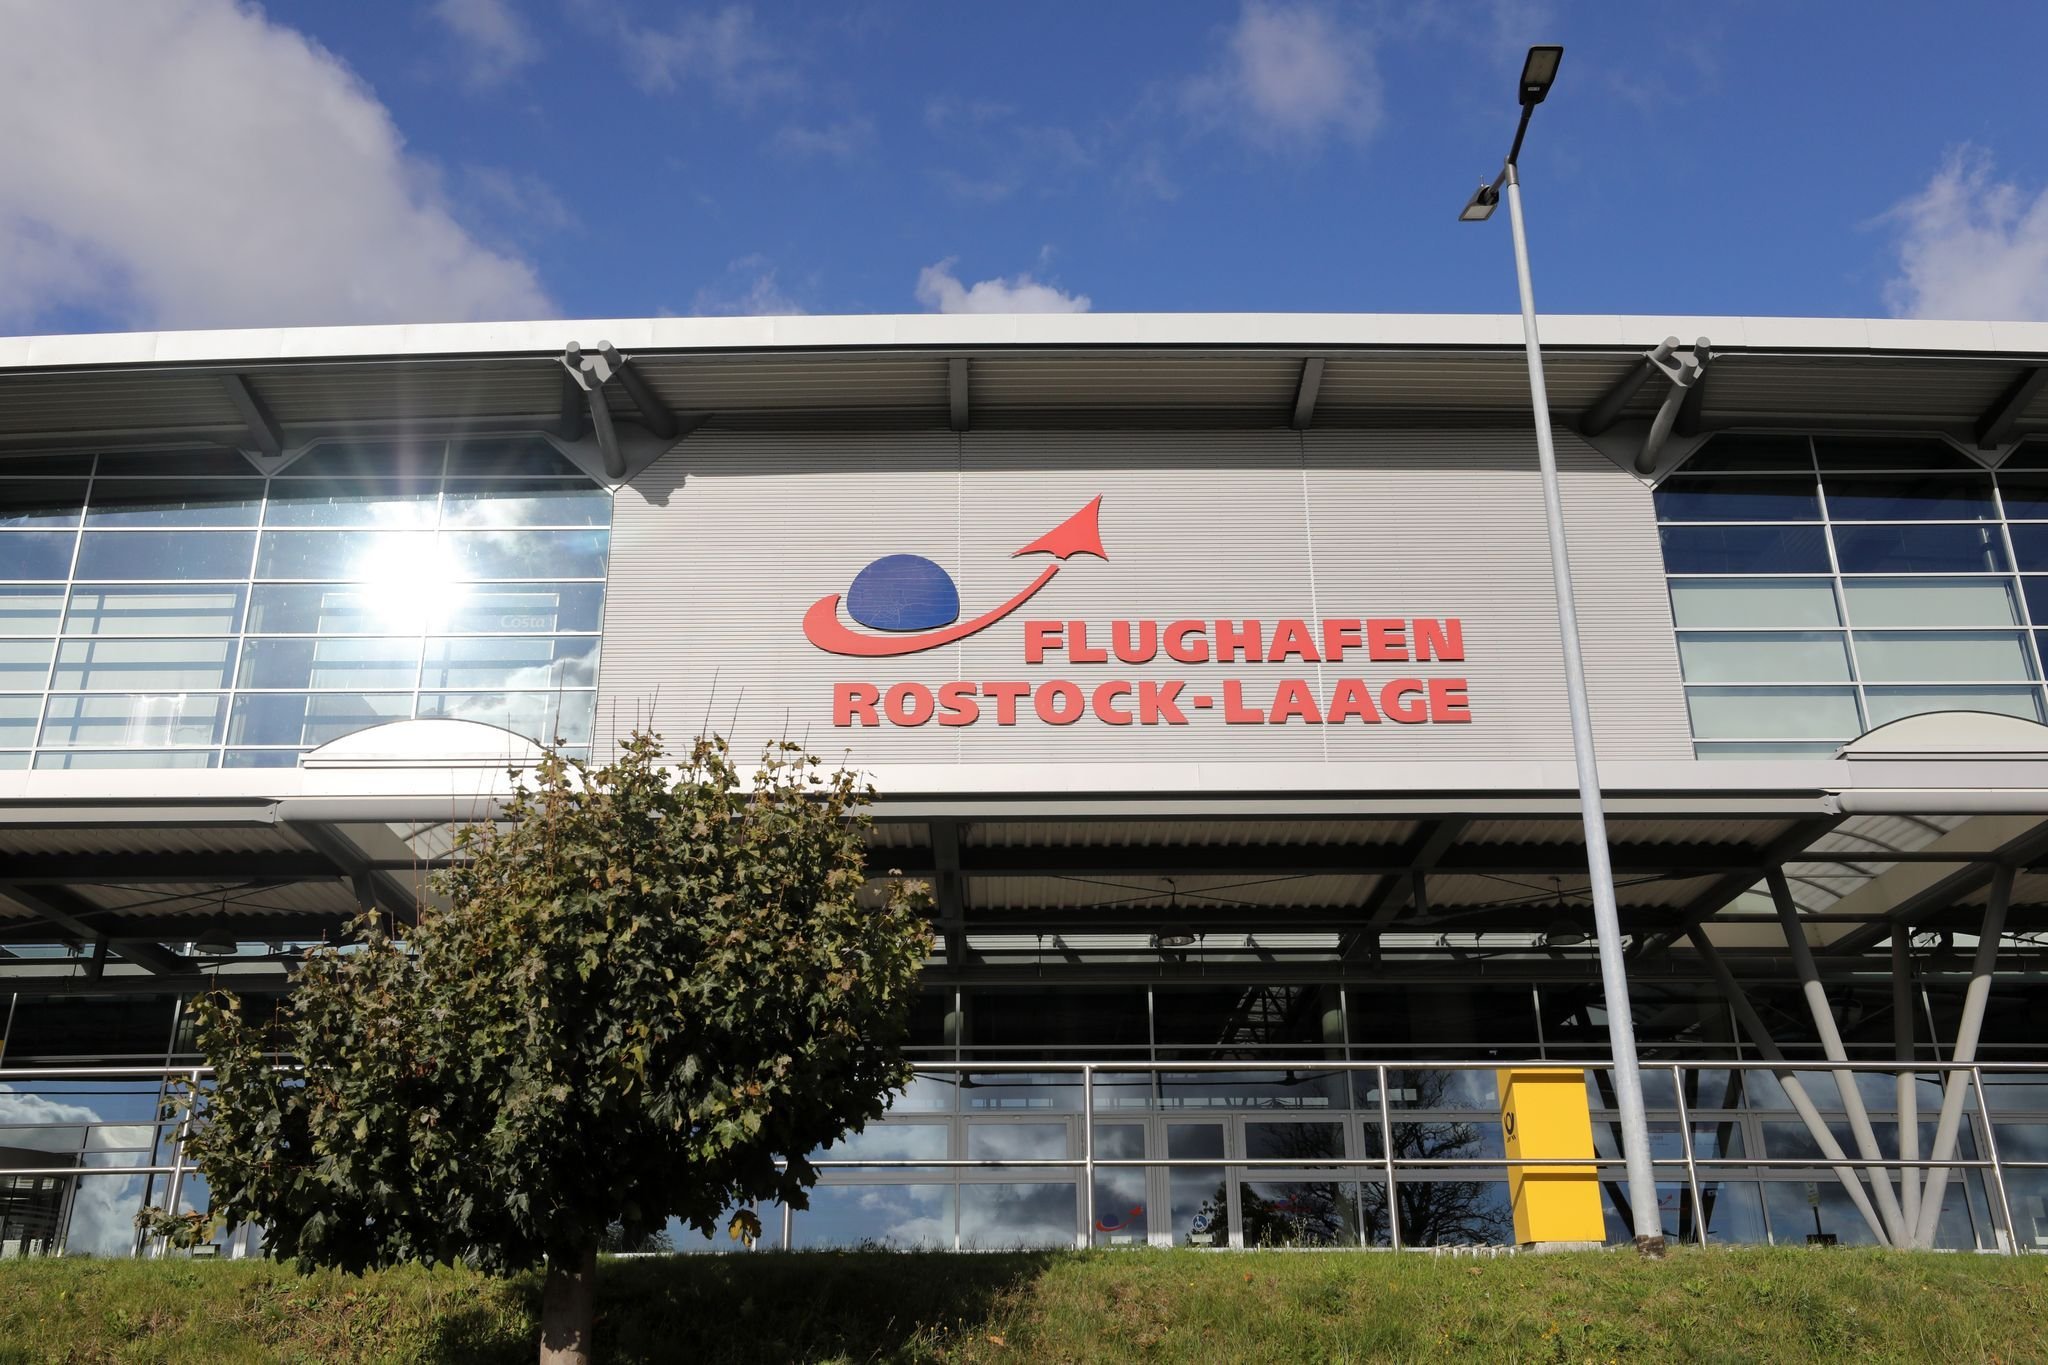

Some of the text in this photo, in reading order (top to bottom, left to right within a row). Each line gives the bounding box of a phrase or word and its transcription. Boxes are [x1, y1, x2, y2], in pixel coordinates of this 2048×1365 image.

[501, 614, 545, 629] Costa
[1024, 619, 1466, 664] FLUGHAFEN
[832, 678, 1472, 727] ROSTOCK-LAAGE
